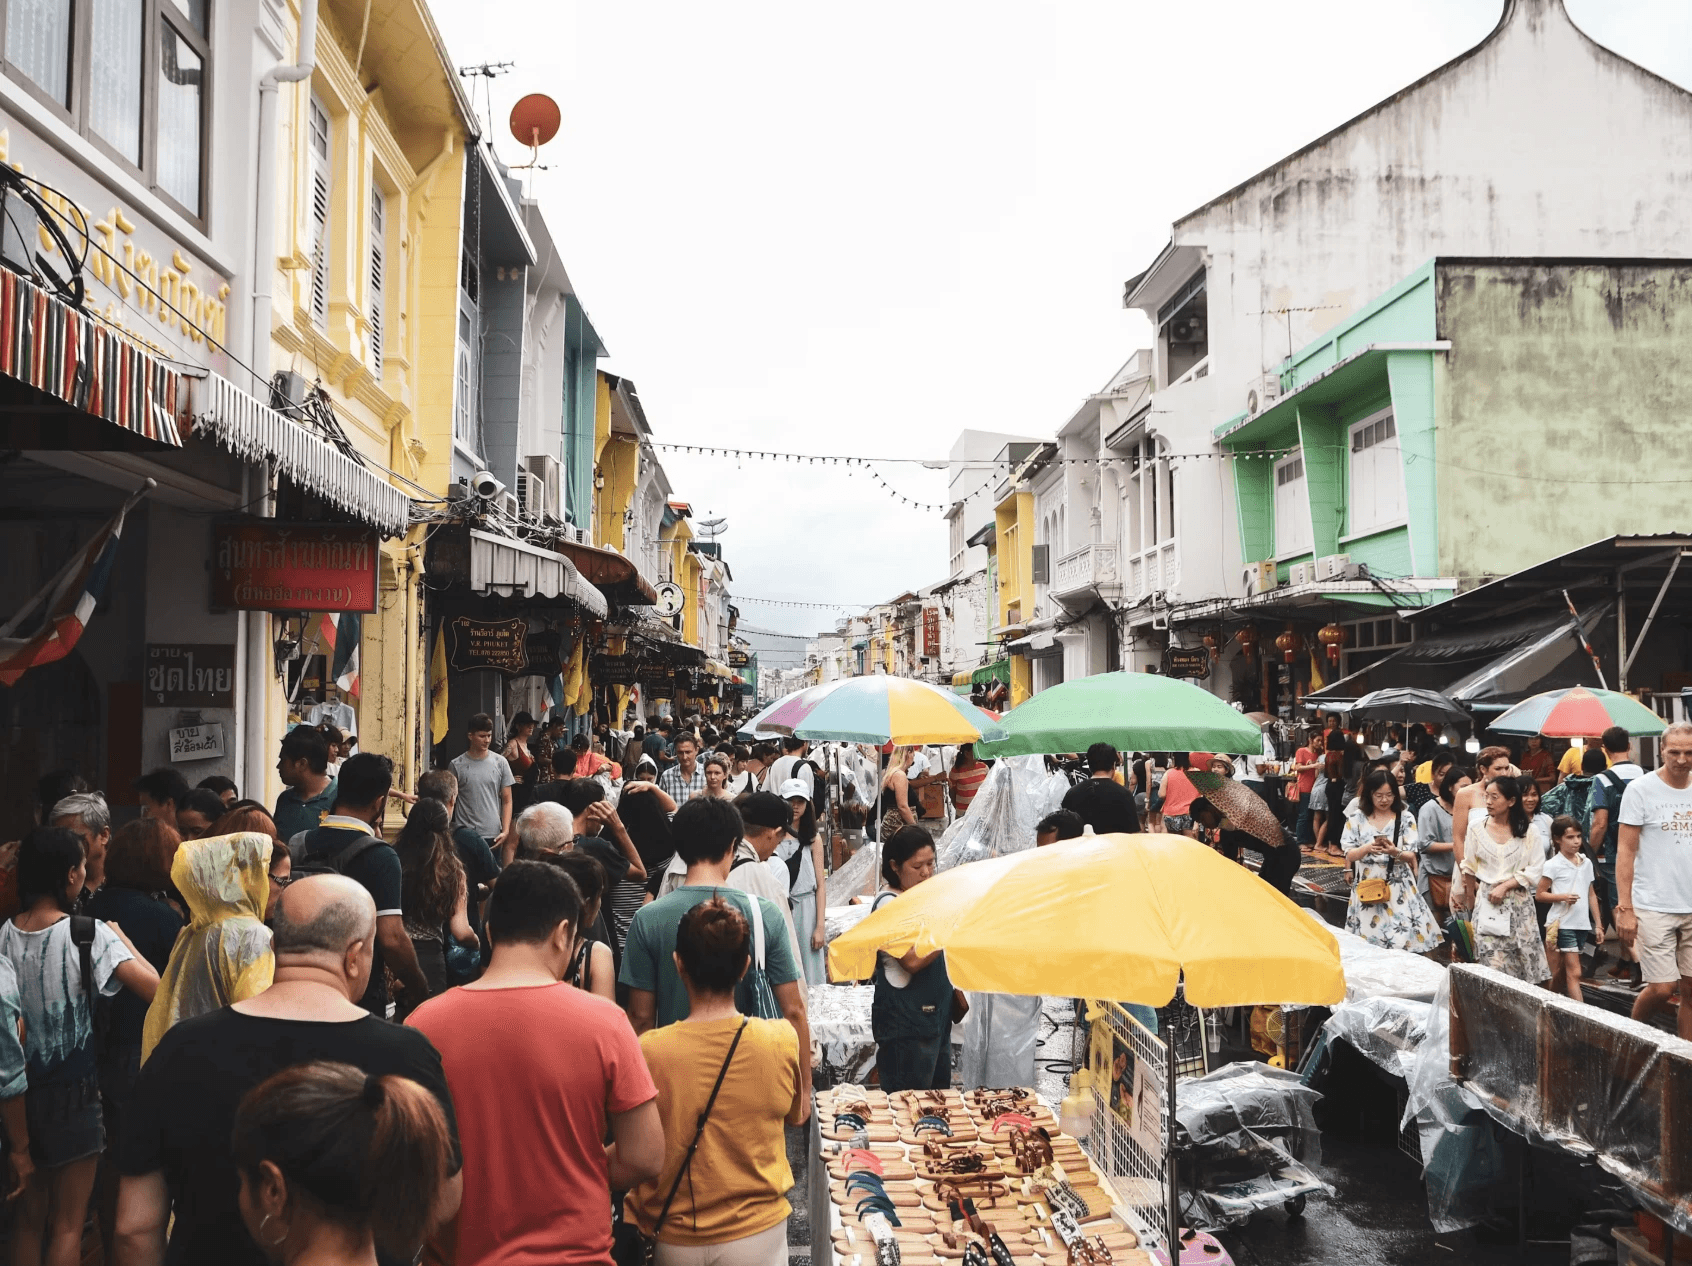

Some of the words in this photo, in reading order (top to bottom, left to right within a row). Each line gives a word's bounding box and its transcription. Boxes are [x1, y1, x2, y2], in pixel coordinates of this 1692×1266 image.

[218, 529, 371, 581] สุนทรสังฆภัณฑ์
[483, 640, 508, 648] PHUKET
[150, 647, 181, 658] ขาย
[148, 651, 232, 704] ชุดไทย
[176, 727, 199, 739] ขาย
